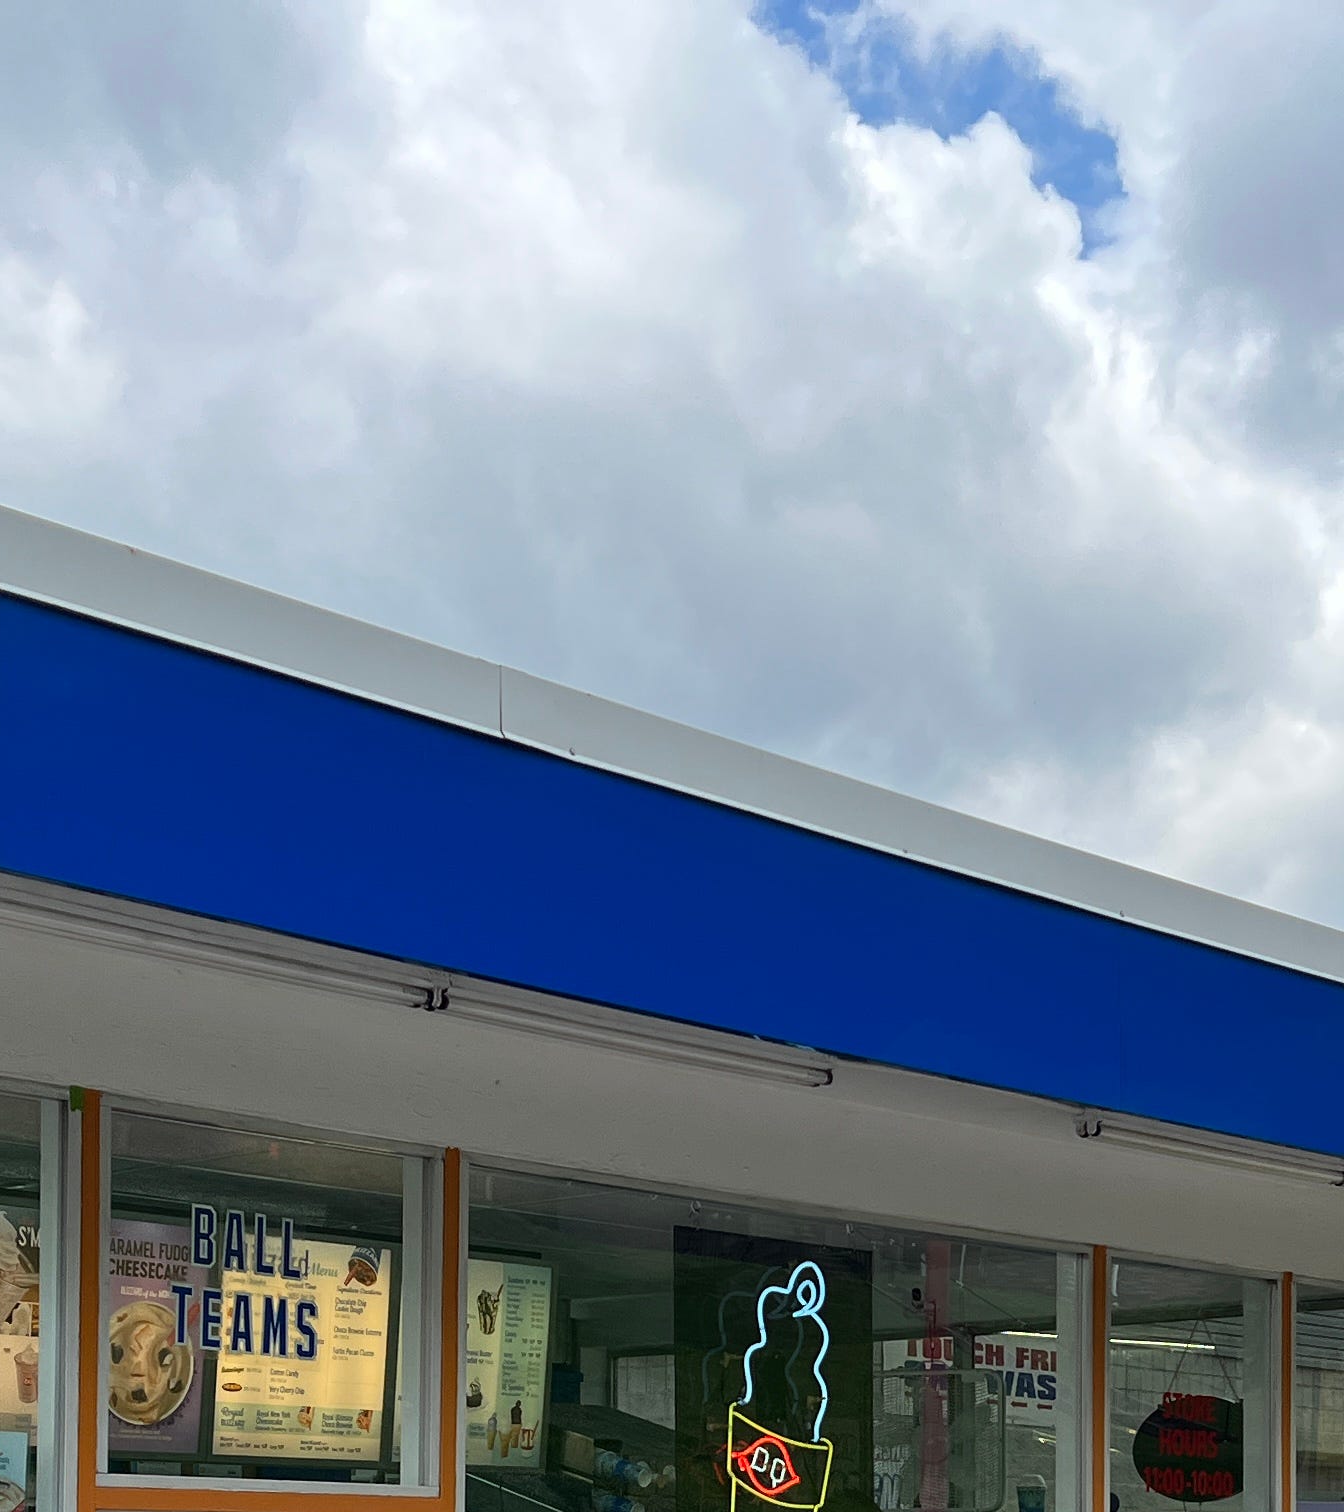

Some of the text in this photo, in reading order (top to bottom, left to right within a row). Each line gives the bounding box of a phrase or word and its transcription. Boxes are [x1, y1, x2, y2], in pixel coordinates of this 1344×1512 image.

[109, 1237, 192, 1262] ARAMEL FUDG
[191, 1202, 310, 1281] BALL
[109, 1258, 189, 1283] CHEESECAKE
[170, 1284, 321, 1361] TEAMS
[1162, 1391, 1217, 1423] STORE
[1158, 1427, 1219, 1459] HOURS
[750, 1446, 787, 1488] DQ
